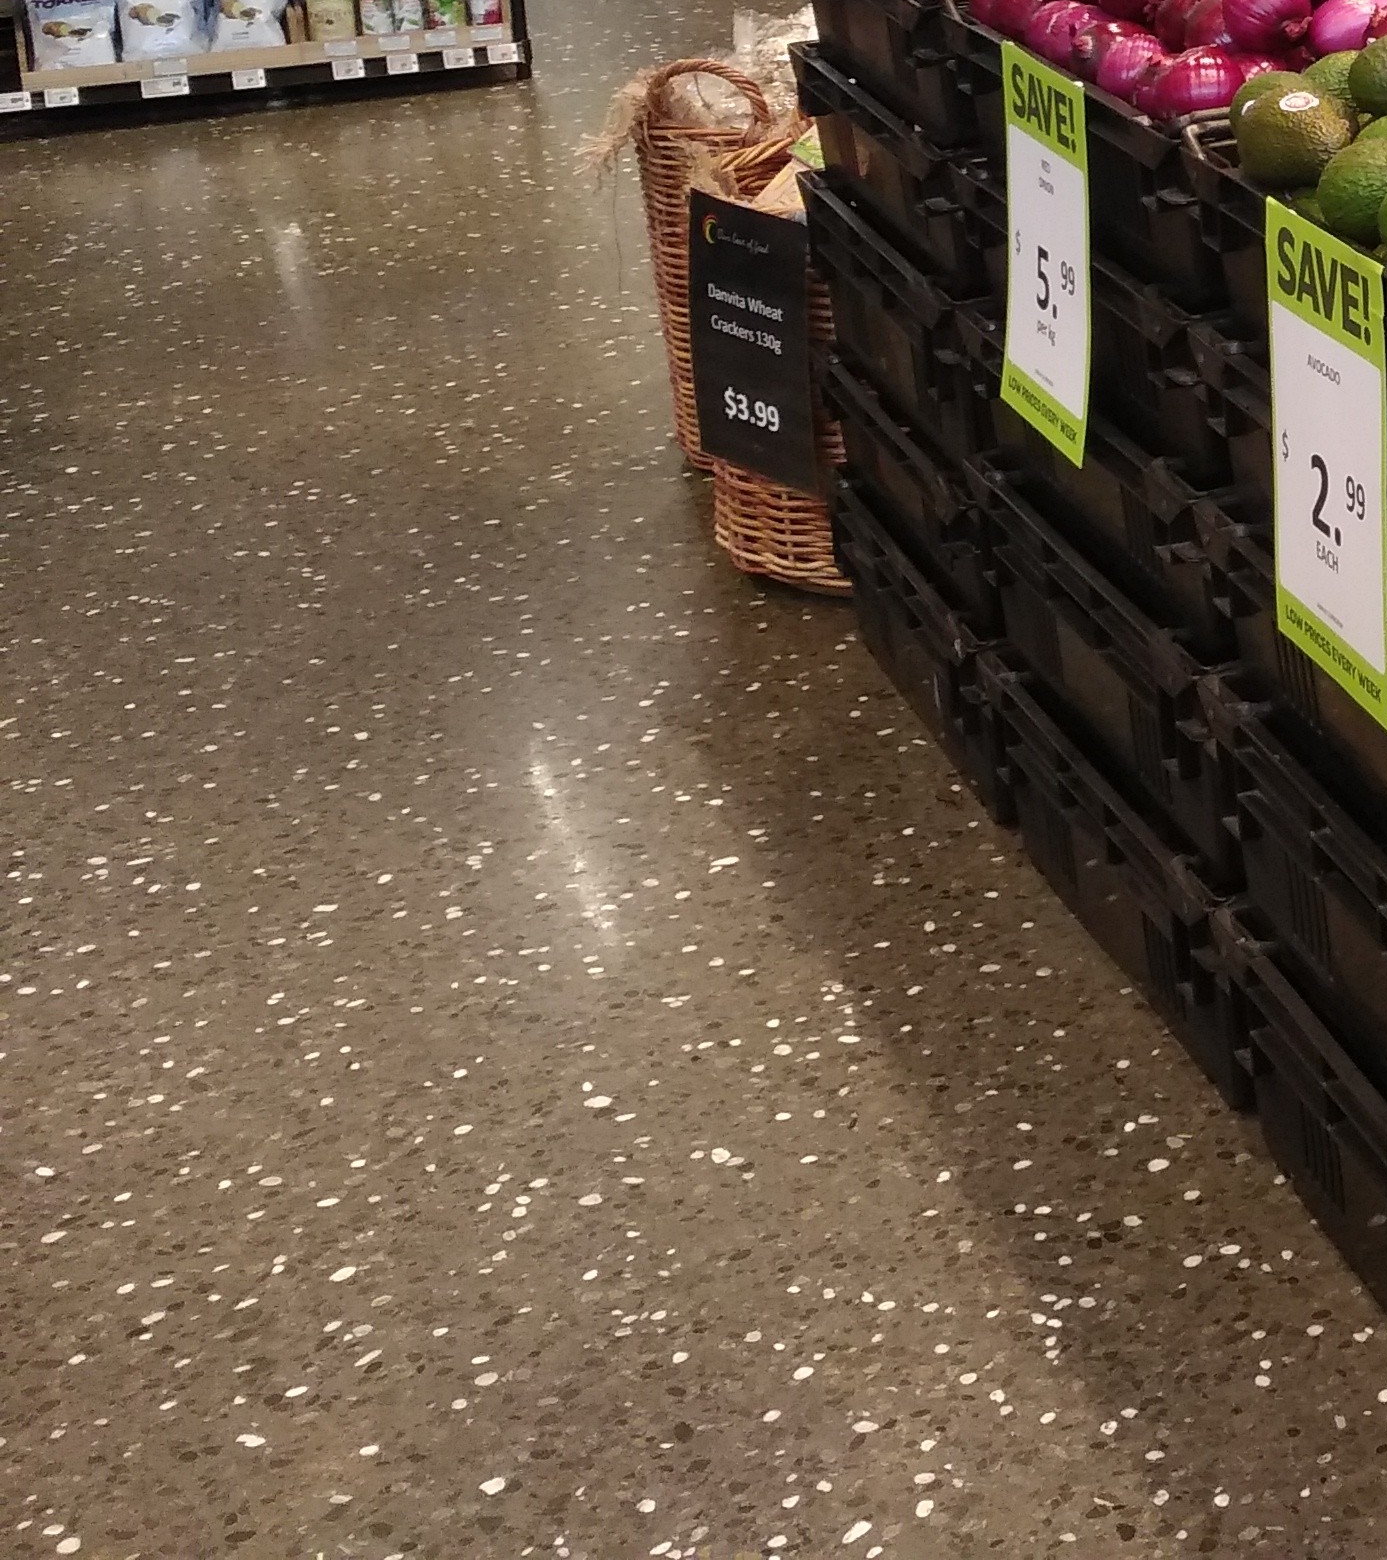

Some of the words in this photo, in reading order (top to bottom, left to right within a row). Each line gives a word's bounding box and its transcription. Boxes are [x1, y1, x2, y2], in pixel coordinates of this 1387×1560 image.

[1011, 61, 1078, 154] SAVE!
[707, 282, 746, 311] Danvita
[748, 295, 785, 322] Wheat
[1276, 225, 1371, 346] SAVE!
[711, 313, 756, 344] Crackers
[756, 328, 782, 356] 130g
[1306, 353, 1341, 387] AVOCADO
[724, 386, 780, 433] $3.99
[1315, 541, 1340, 576] EACH
